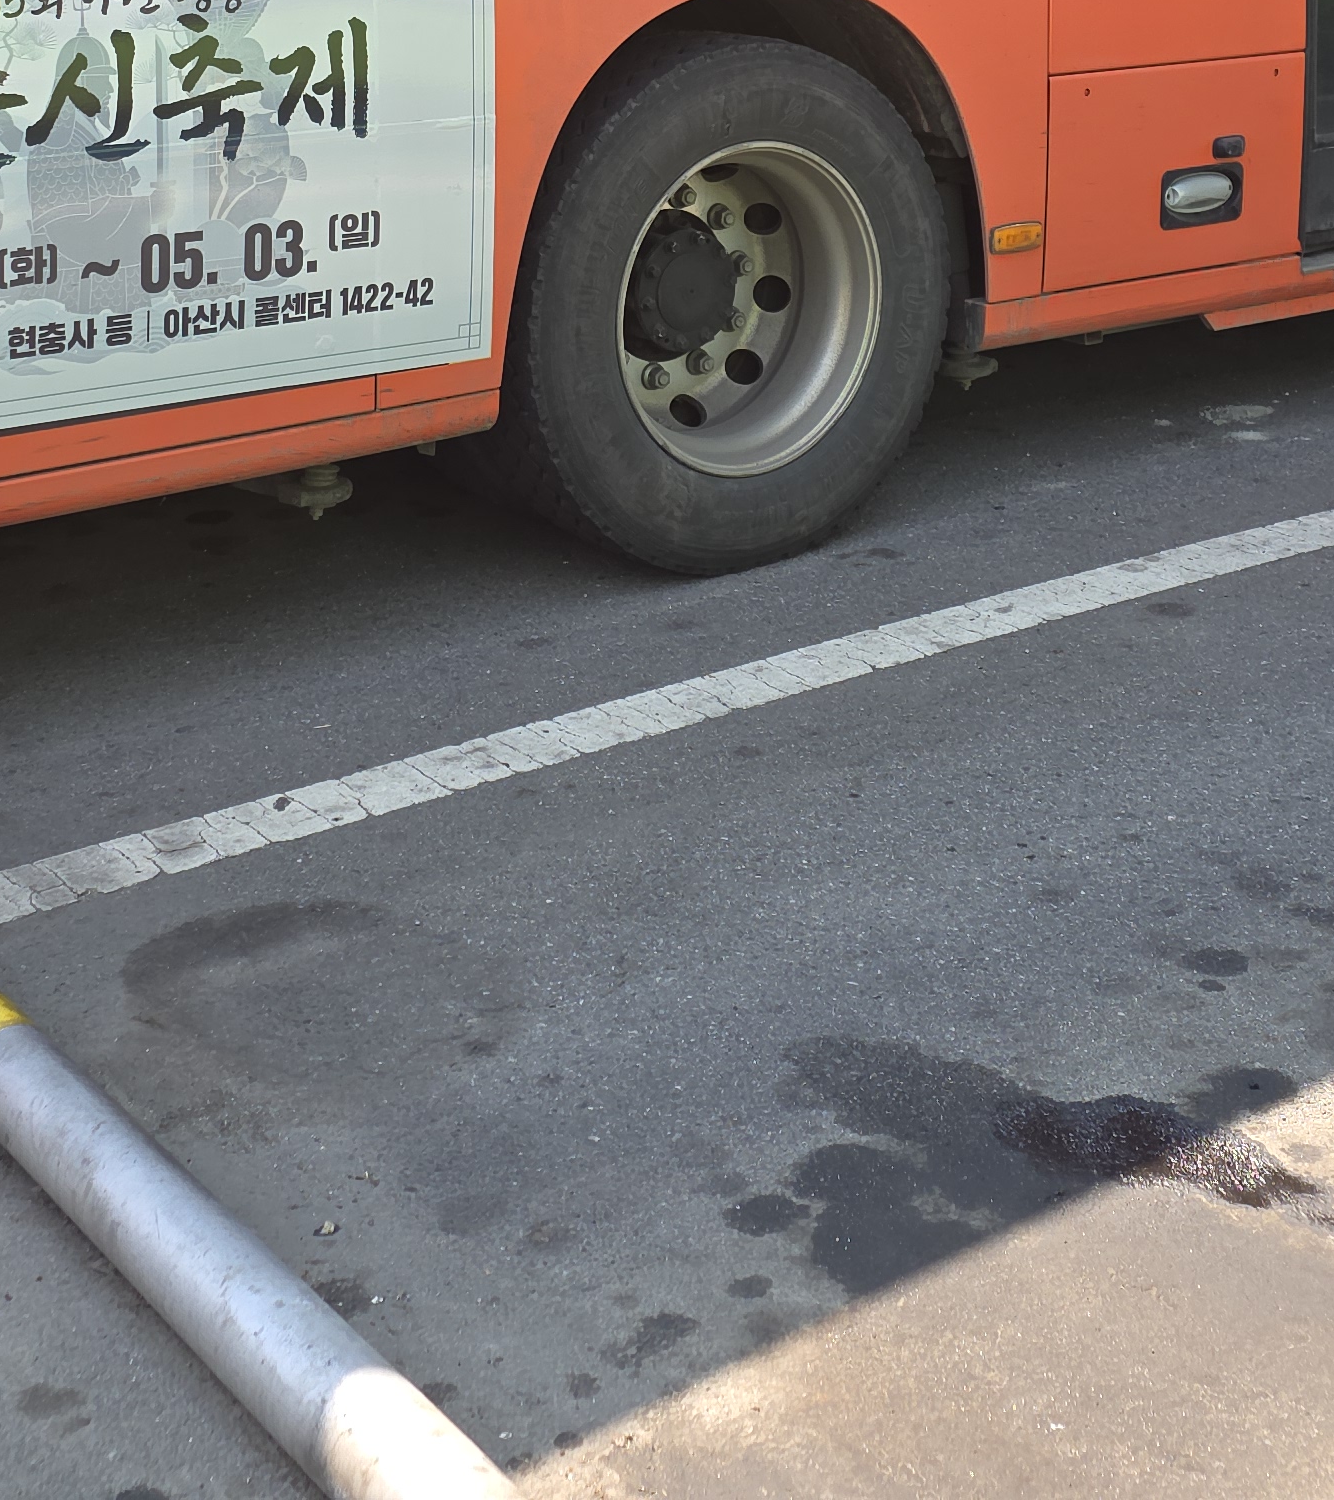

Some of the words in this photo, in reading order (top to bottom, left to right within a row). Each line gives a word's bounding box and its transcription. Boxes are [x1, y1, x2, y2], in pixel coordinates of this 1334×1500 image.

[140, 230, 218, 294] 05.
[243, 219, 317, 282] 03.
[7, 317, 97, 361] 현충사
[105, 313, 132, 347] 등
[163, 299, 245, 339] 아산시
[254, 288, 332, 328] 콜센터
[339, 277, 434, 317] 1422-42
